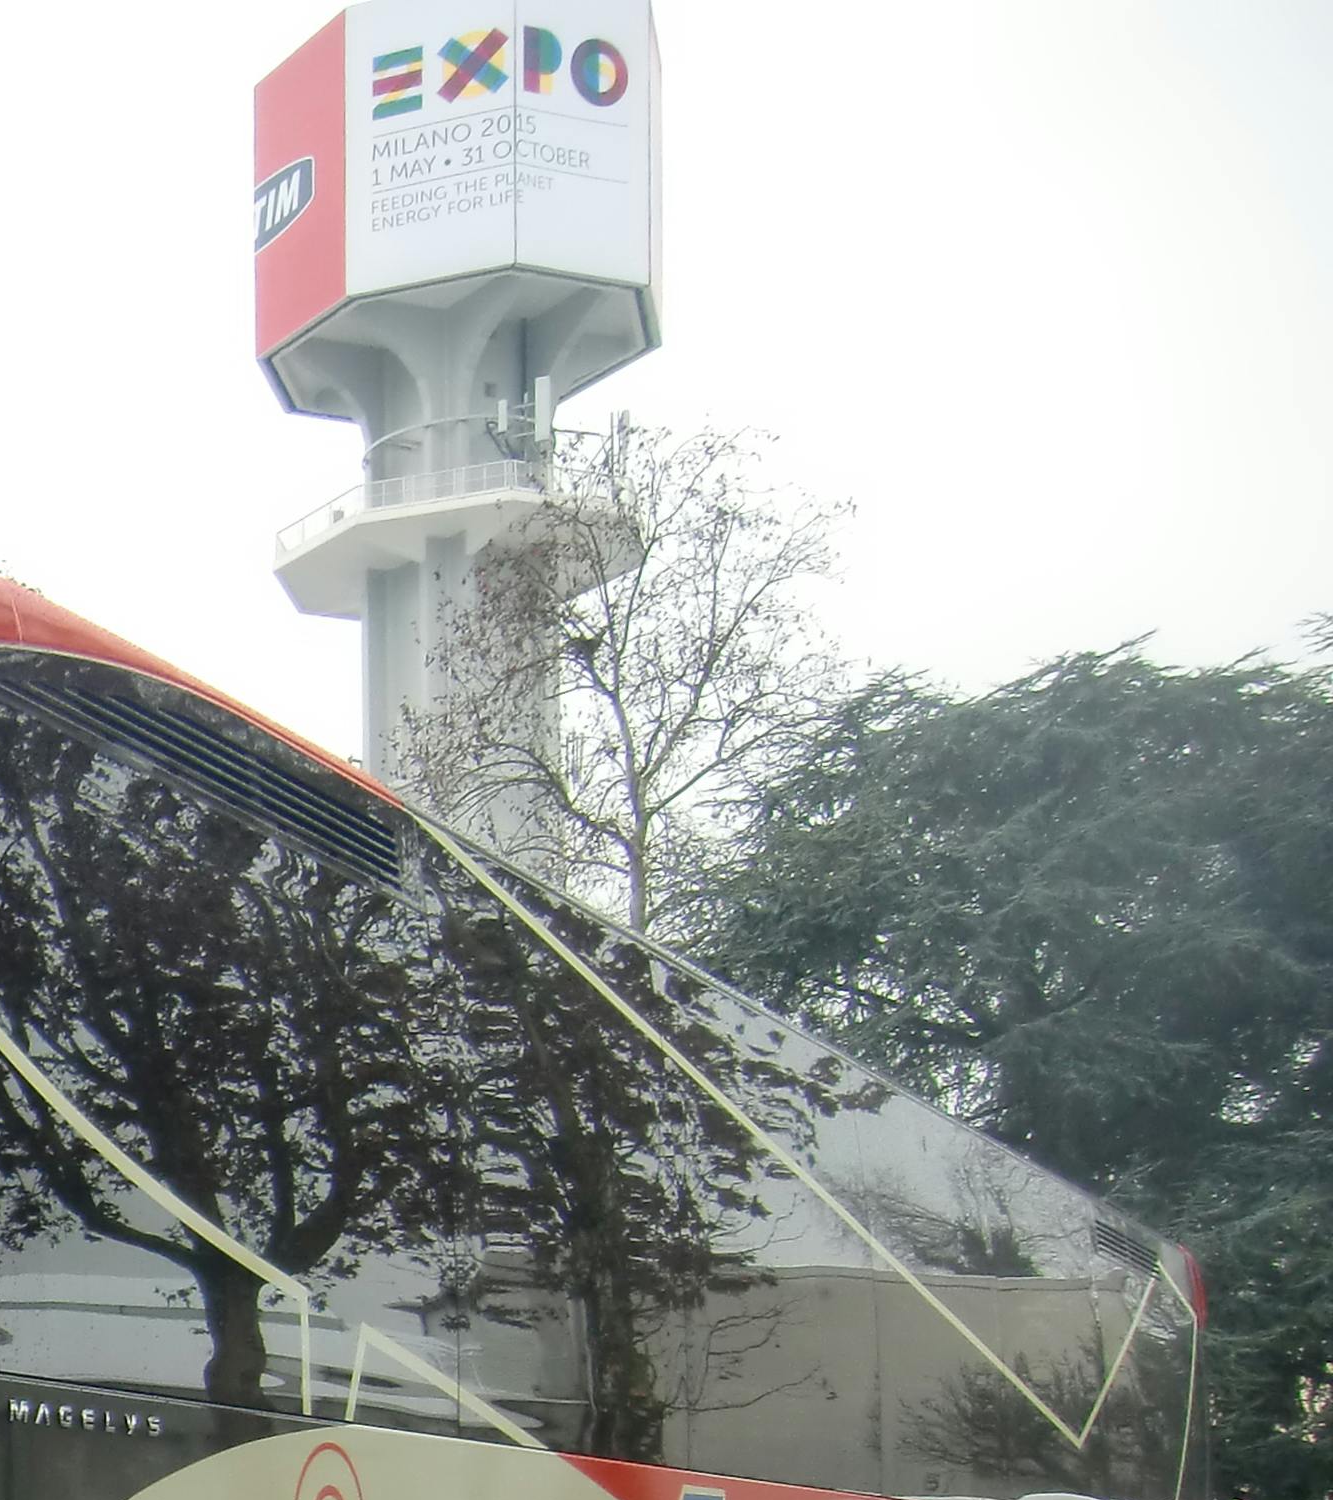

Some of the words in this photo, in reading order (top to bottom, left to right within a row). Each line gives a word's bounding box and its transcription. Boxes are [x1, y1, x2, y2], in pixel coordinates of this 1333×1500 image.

[372, 25, 629, 121] EXPO
[371, 122, 472, 162] MILANO
[481, 112, 537, 138] 2015
[372, 168, 382, 187] 1
[389, 155, 437, 183] MAY
[461, 144, 484, 167] 31
[492, 138, 591, 170] OCTOBER
[253, 167, 301, 241] TIM
[371, 184, 448, 215] FEEDING
[453, 175, 489, 195] THE
[494, 171, 555, 192] PLANET
[371, 203, 443, 233] ENERGY
[447, 194, 483, 215] FOR
[489, 188, 525, 207] LIFE
[8, 1398, 162, 1438] MAGELYS
